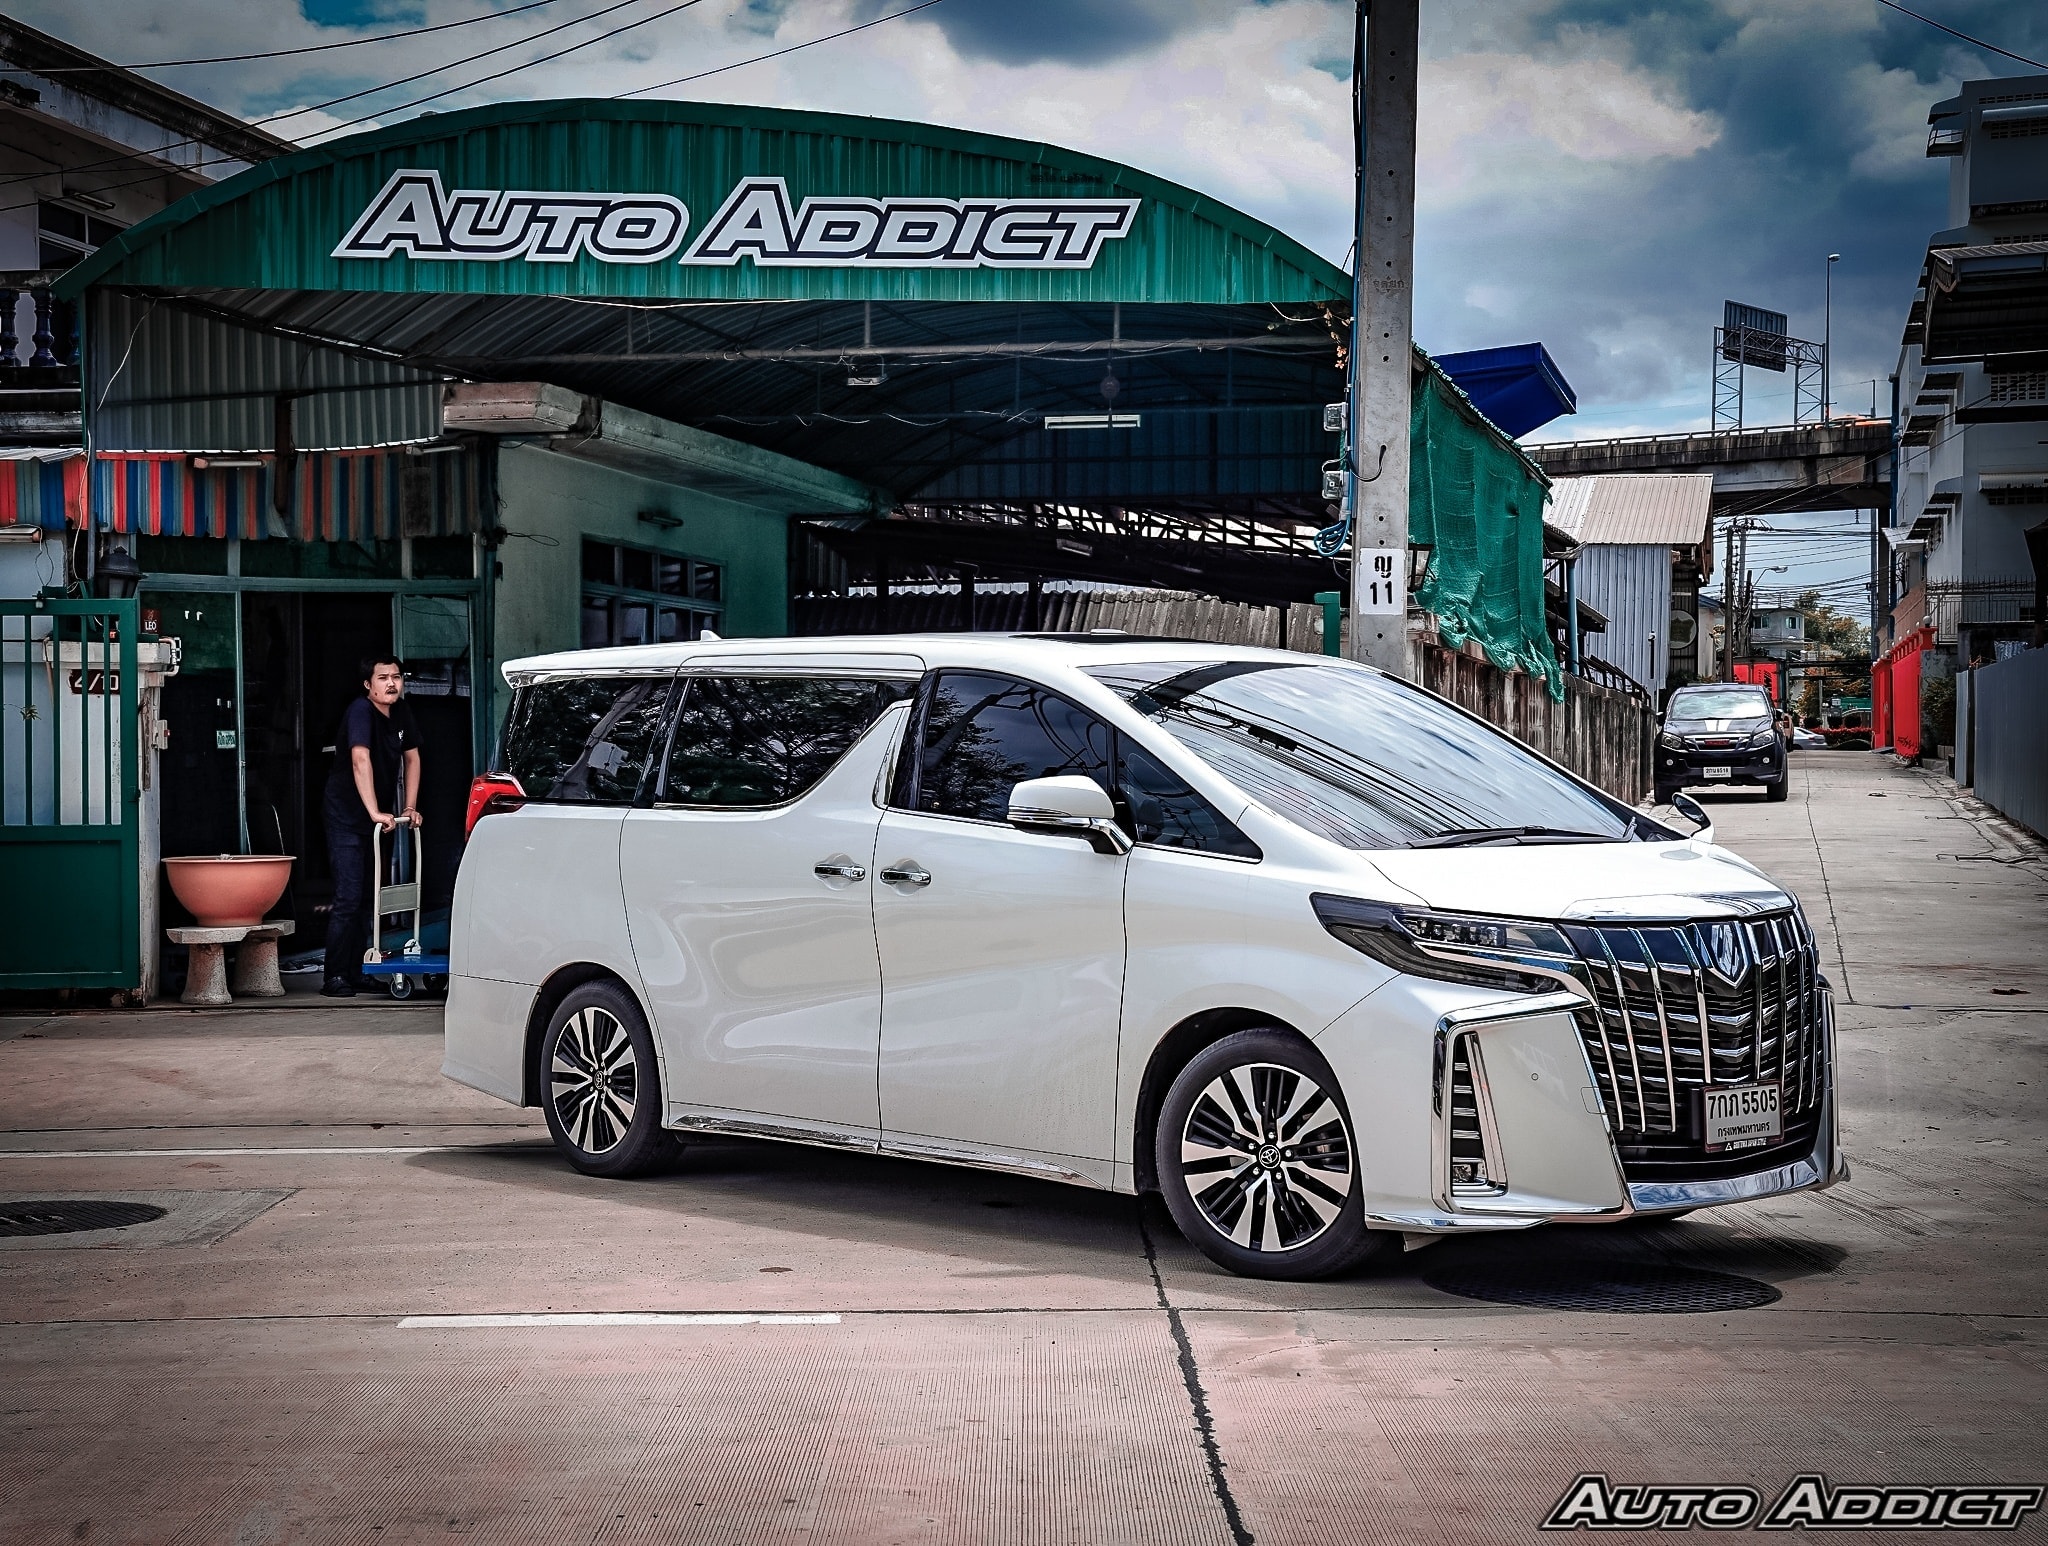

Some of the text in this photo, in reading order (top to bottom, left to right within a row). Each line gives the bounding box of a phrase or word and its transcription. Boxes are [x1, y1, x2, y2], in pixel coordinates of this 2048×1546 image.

[331, 169, 1141, 269] AUTO ADDICT
[1742, 1089, 1777, 1115] 5505
[1717, 1121, 1770, 1140] กรุงเทพมหานคร
